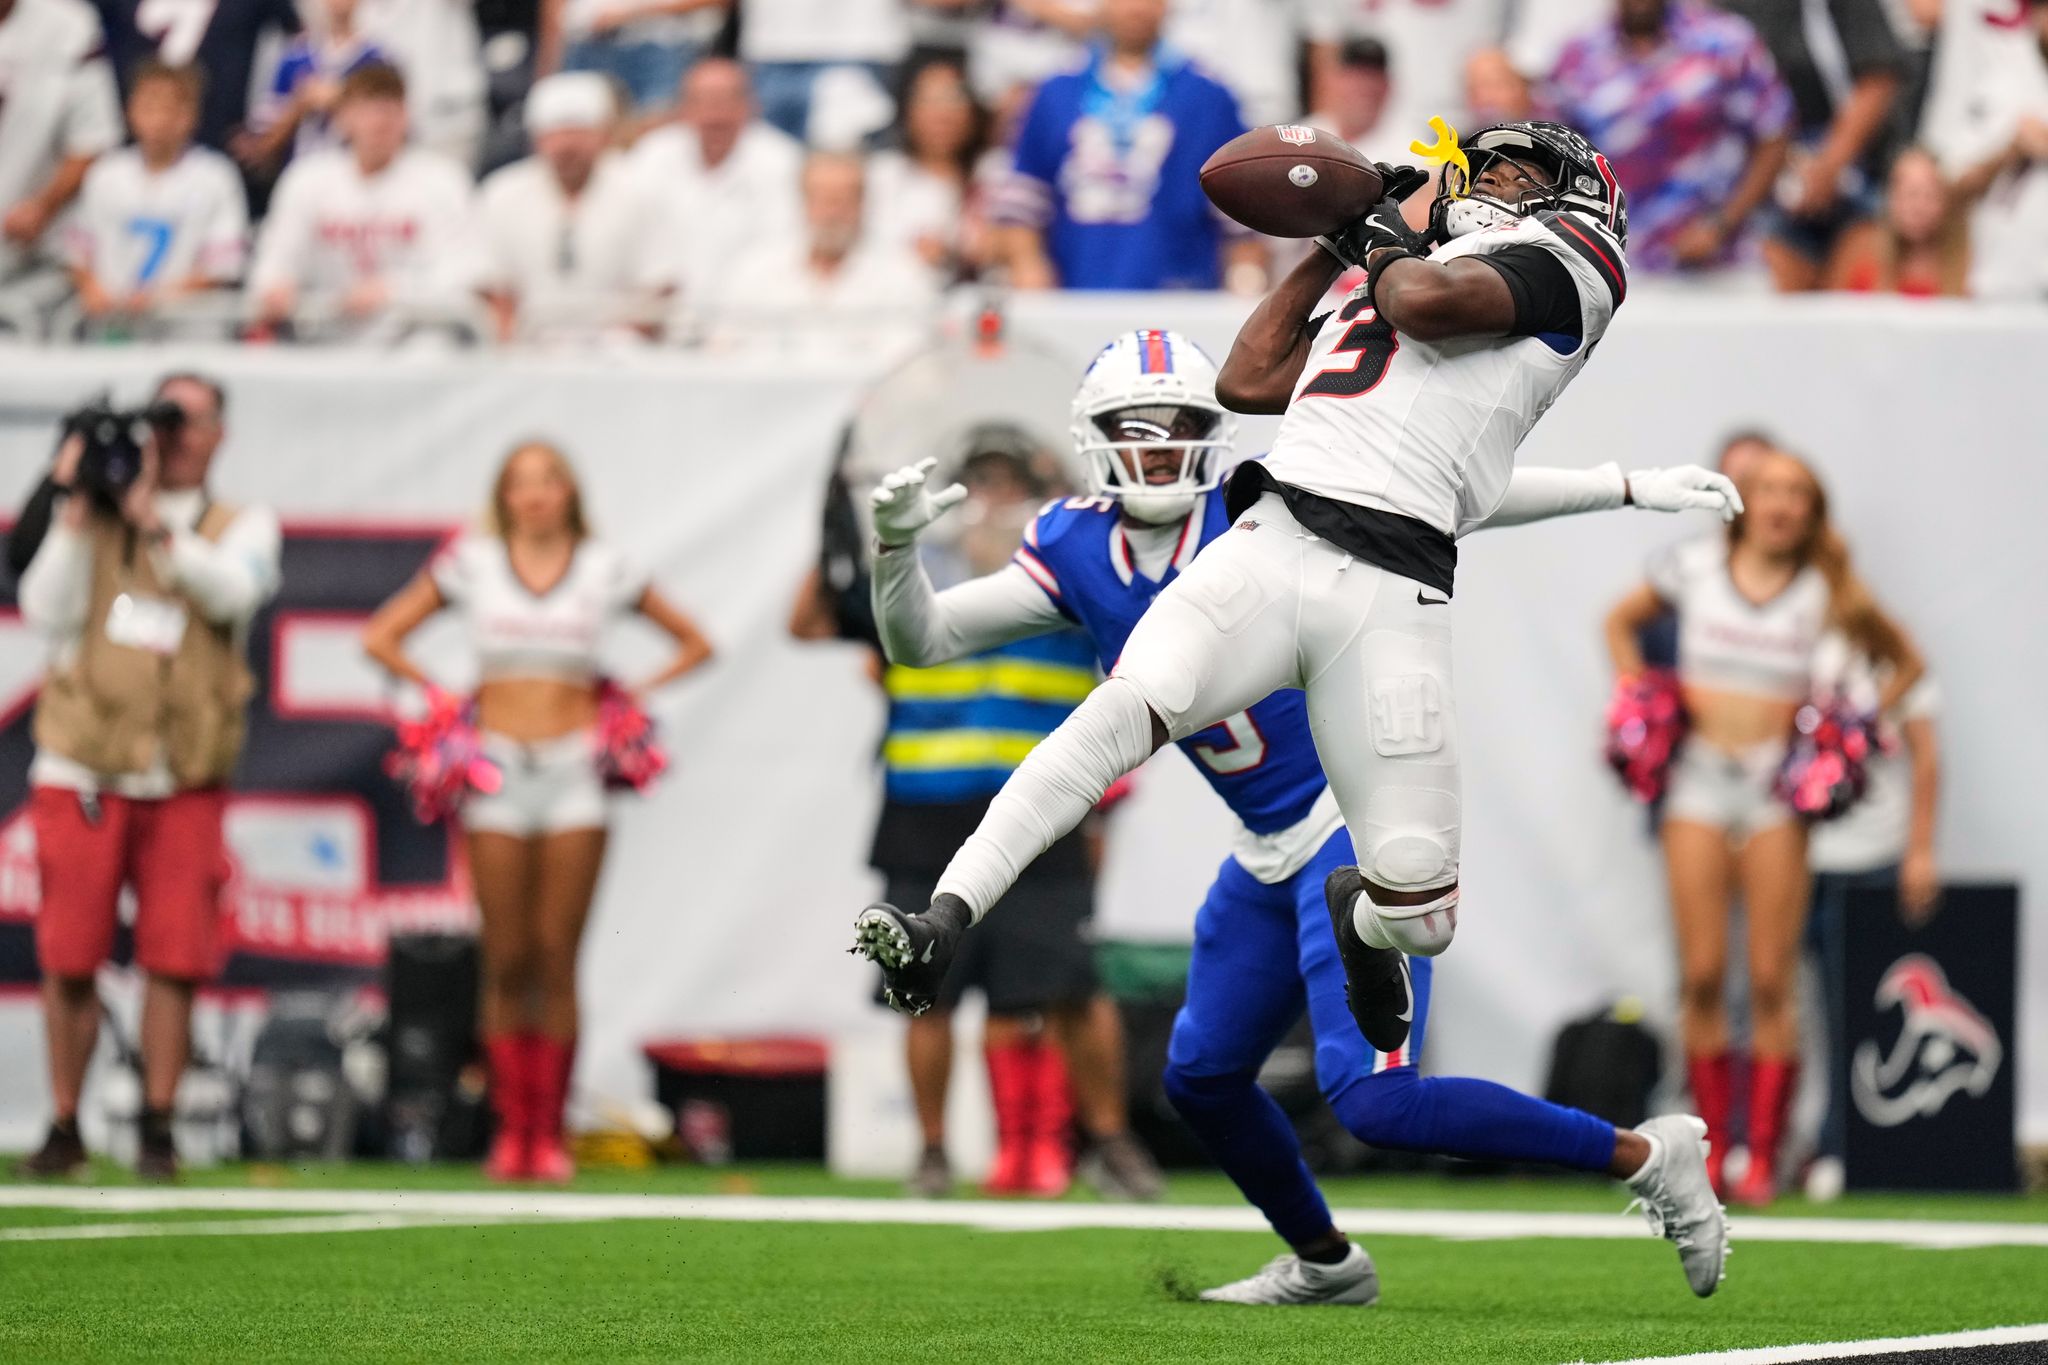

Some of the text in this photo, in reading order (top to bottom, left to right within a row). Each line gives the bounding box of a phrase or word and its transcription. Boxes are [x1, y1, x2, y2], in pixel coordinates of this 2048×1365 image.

[1283, 129, 1312, 140] NFL
[128, 217, 174, 283] 7
[1293, 296, 1400, 404] 3
